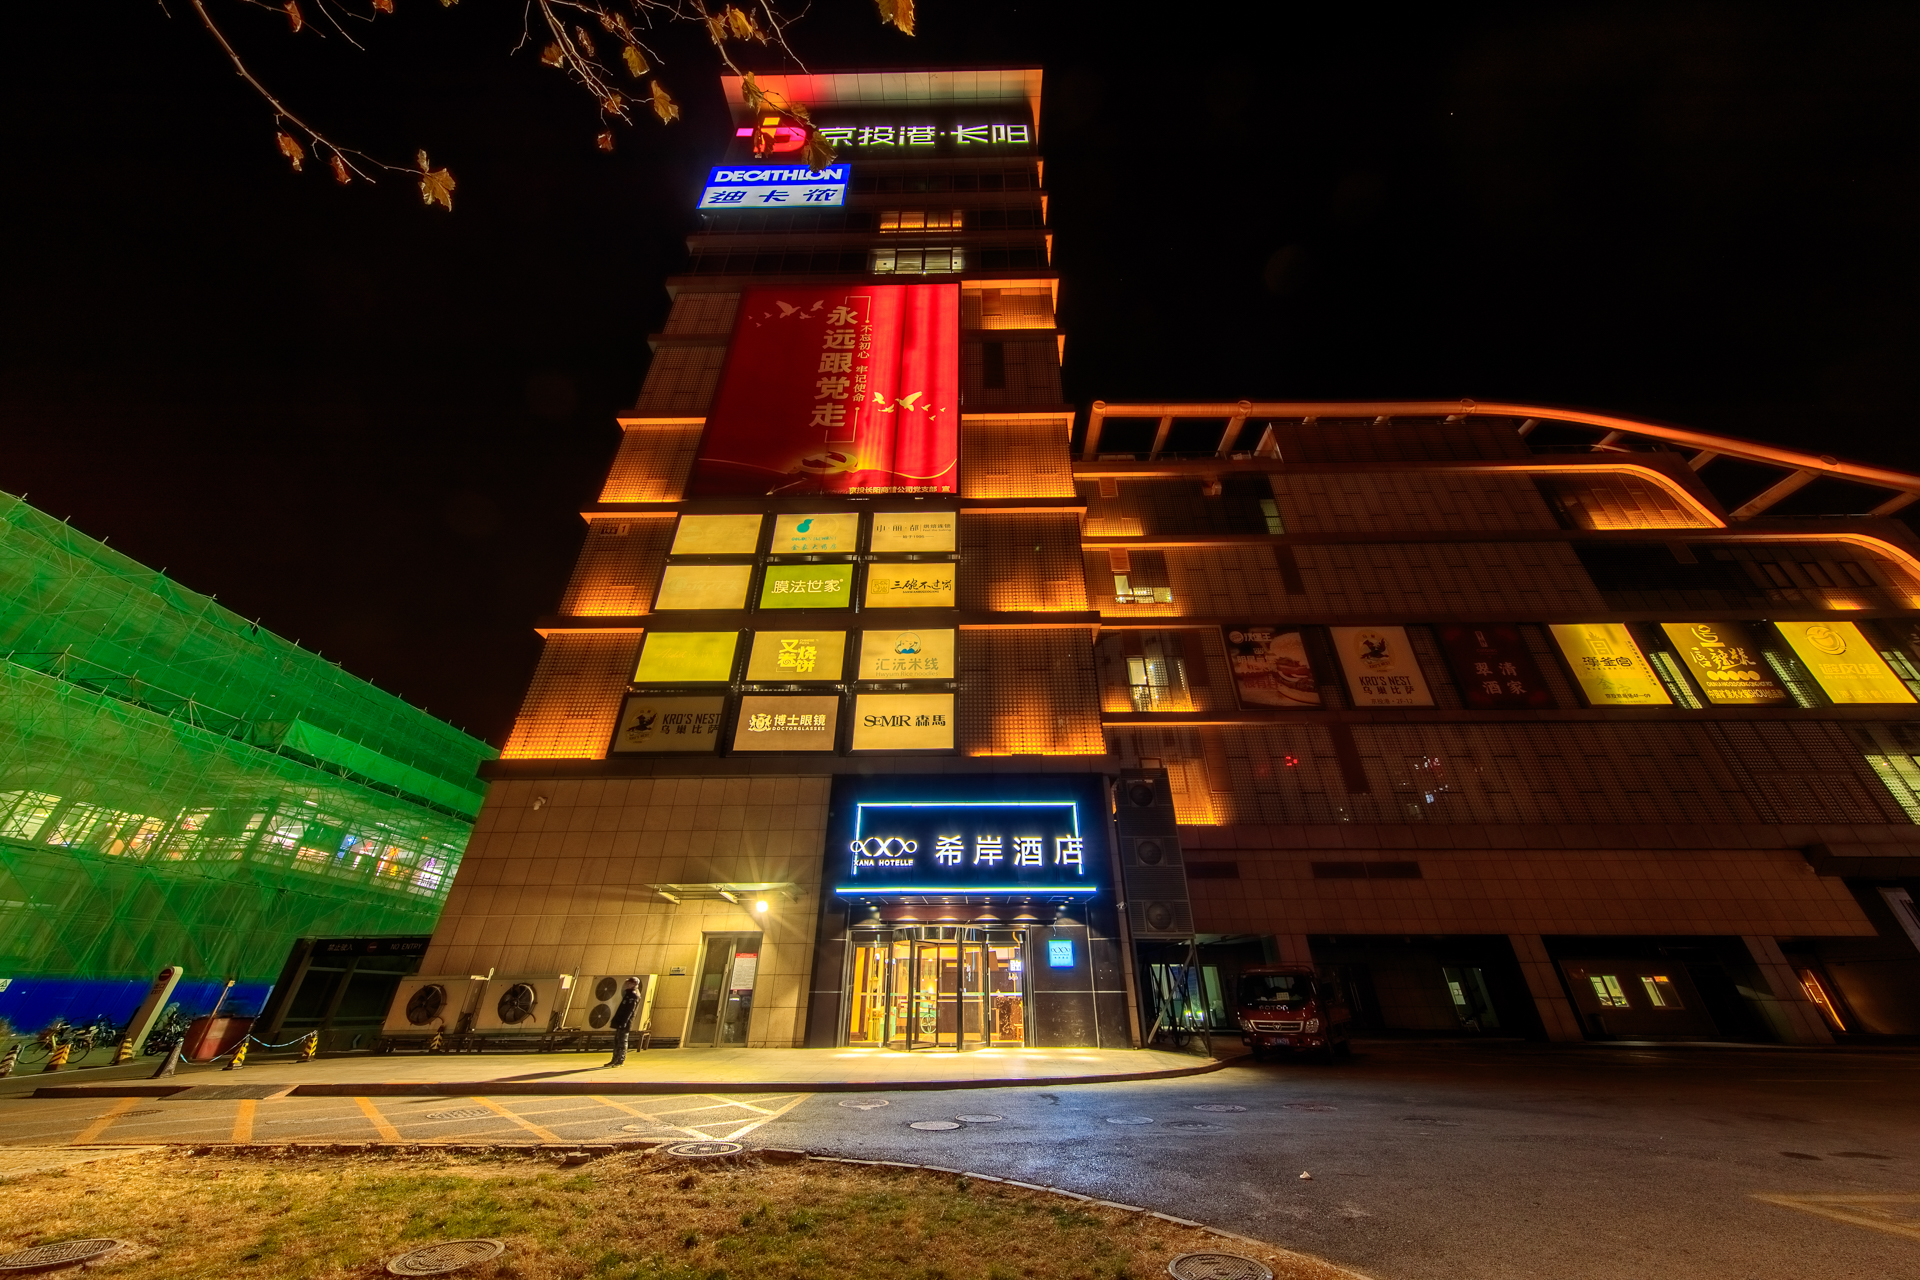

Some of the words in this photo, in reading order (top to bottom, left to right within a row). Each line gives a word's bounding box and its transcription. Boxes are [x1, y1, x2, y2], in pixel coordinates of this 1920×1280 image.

[714, 167, 843, 183] DECATHLON
[708, 187, 838, 204] 迪卡侬
[857, 324, 873, 359] 不忘初心
[809, 305, 859, 427] 永远跟党走
[852, 365, 868, 402] 牢记使命
[771, 579, 841, 594] 膜法世家
[876, 657, 939, 671] 汇沅米线
[1358, 676, 1387, 685] KRO'S
[1387, 675, 1412, 686] NEST
[1482, 680, 1528, 694] 酒家
[662, 713, 692, 724] KRO'S
[774, 714, 827, 727] 博士眼镜
[864, 715, 912, 727] SEMIR
[935, 834, 1084, 867] 希岸酒店
[878, 859, 914, 867] HOTELLE
[390, 943, 400, 951] NO
[401, 943, 424, 951] ENTRY
